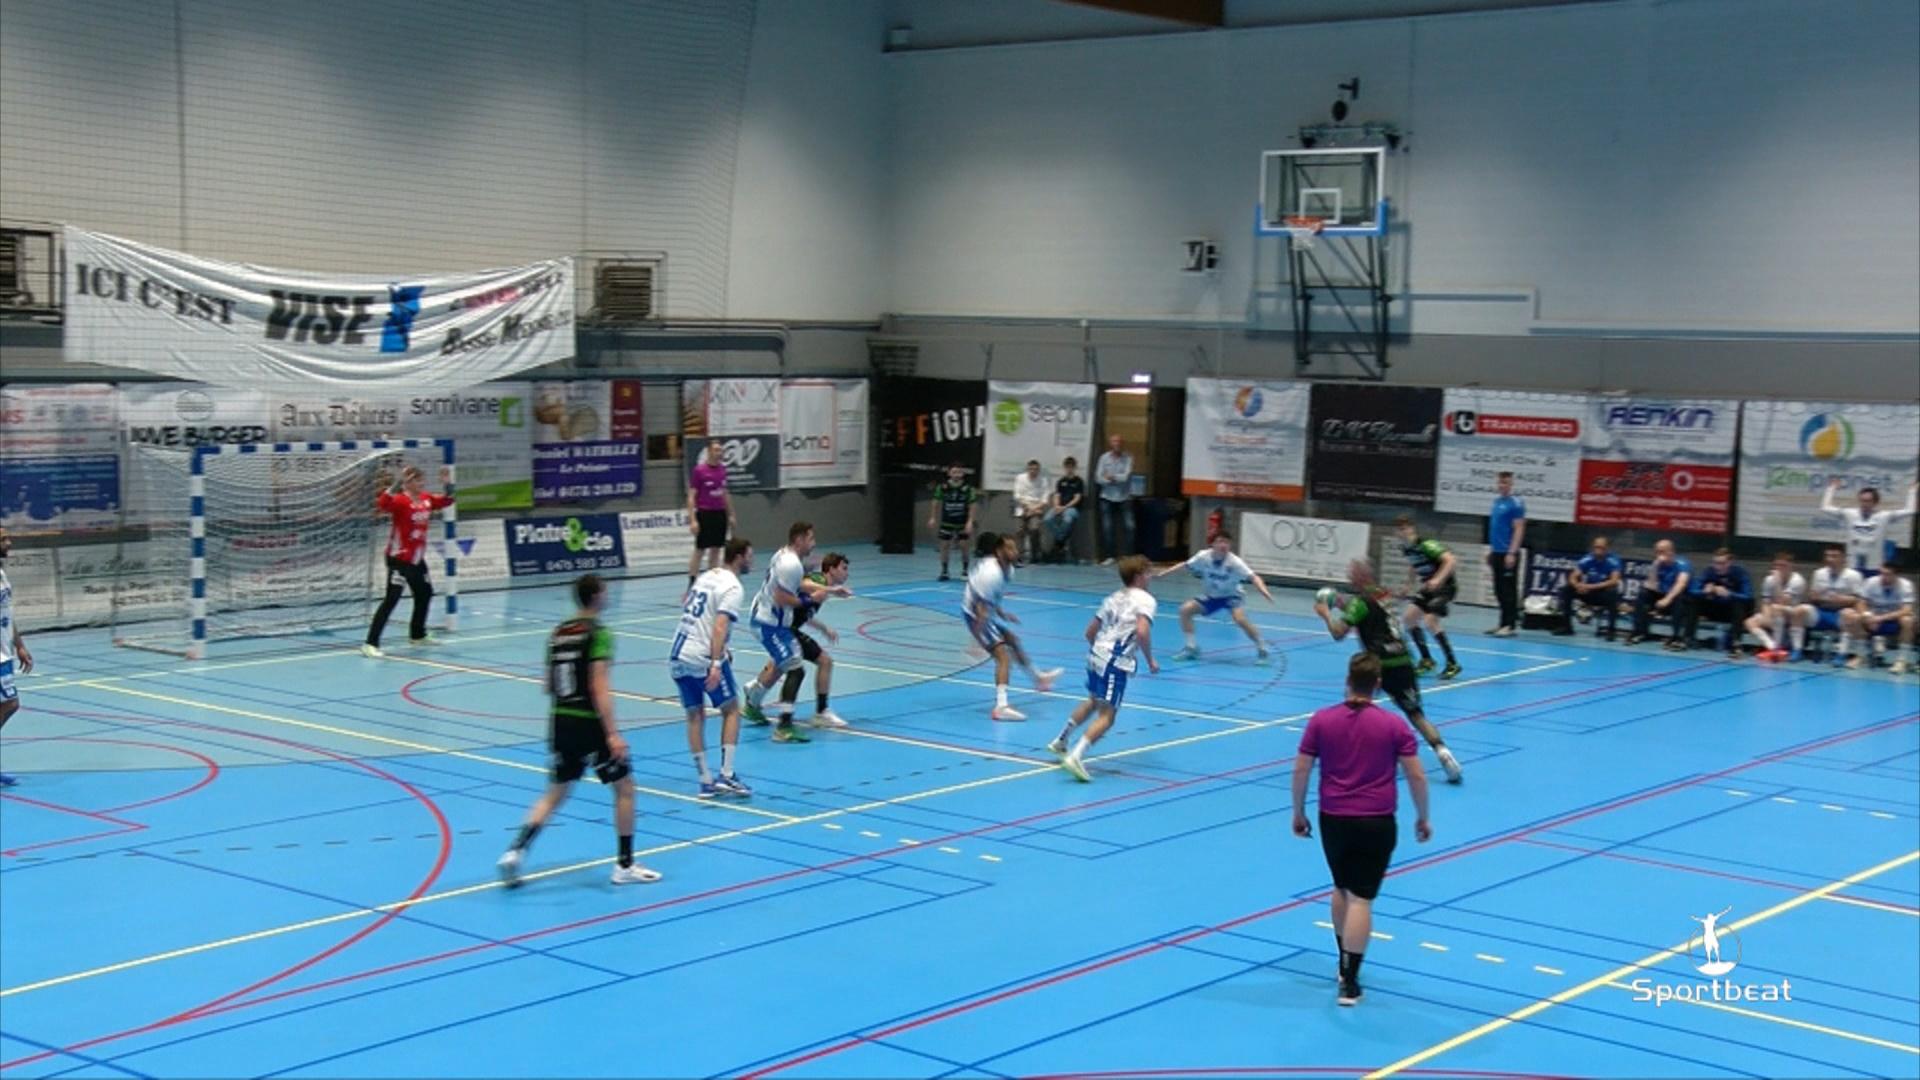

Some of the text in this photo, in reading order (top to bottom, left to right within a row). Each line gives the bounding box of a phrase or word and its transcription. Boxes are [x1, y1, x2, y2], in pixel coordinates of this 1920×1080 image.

[76, 263, 237, 325] ICI C'EST
[264, 288, 376, 344] VISE
[410, 394, 499, 416] somivane
[1481, 419, 1574, 435] TRAVHYDRO
[1461, 452, 1538, 465] LOCATION
